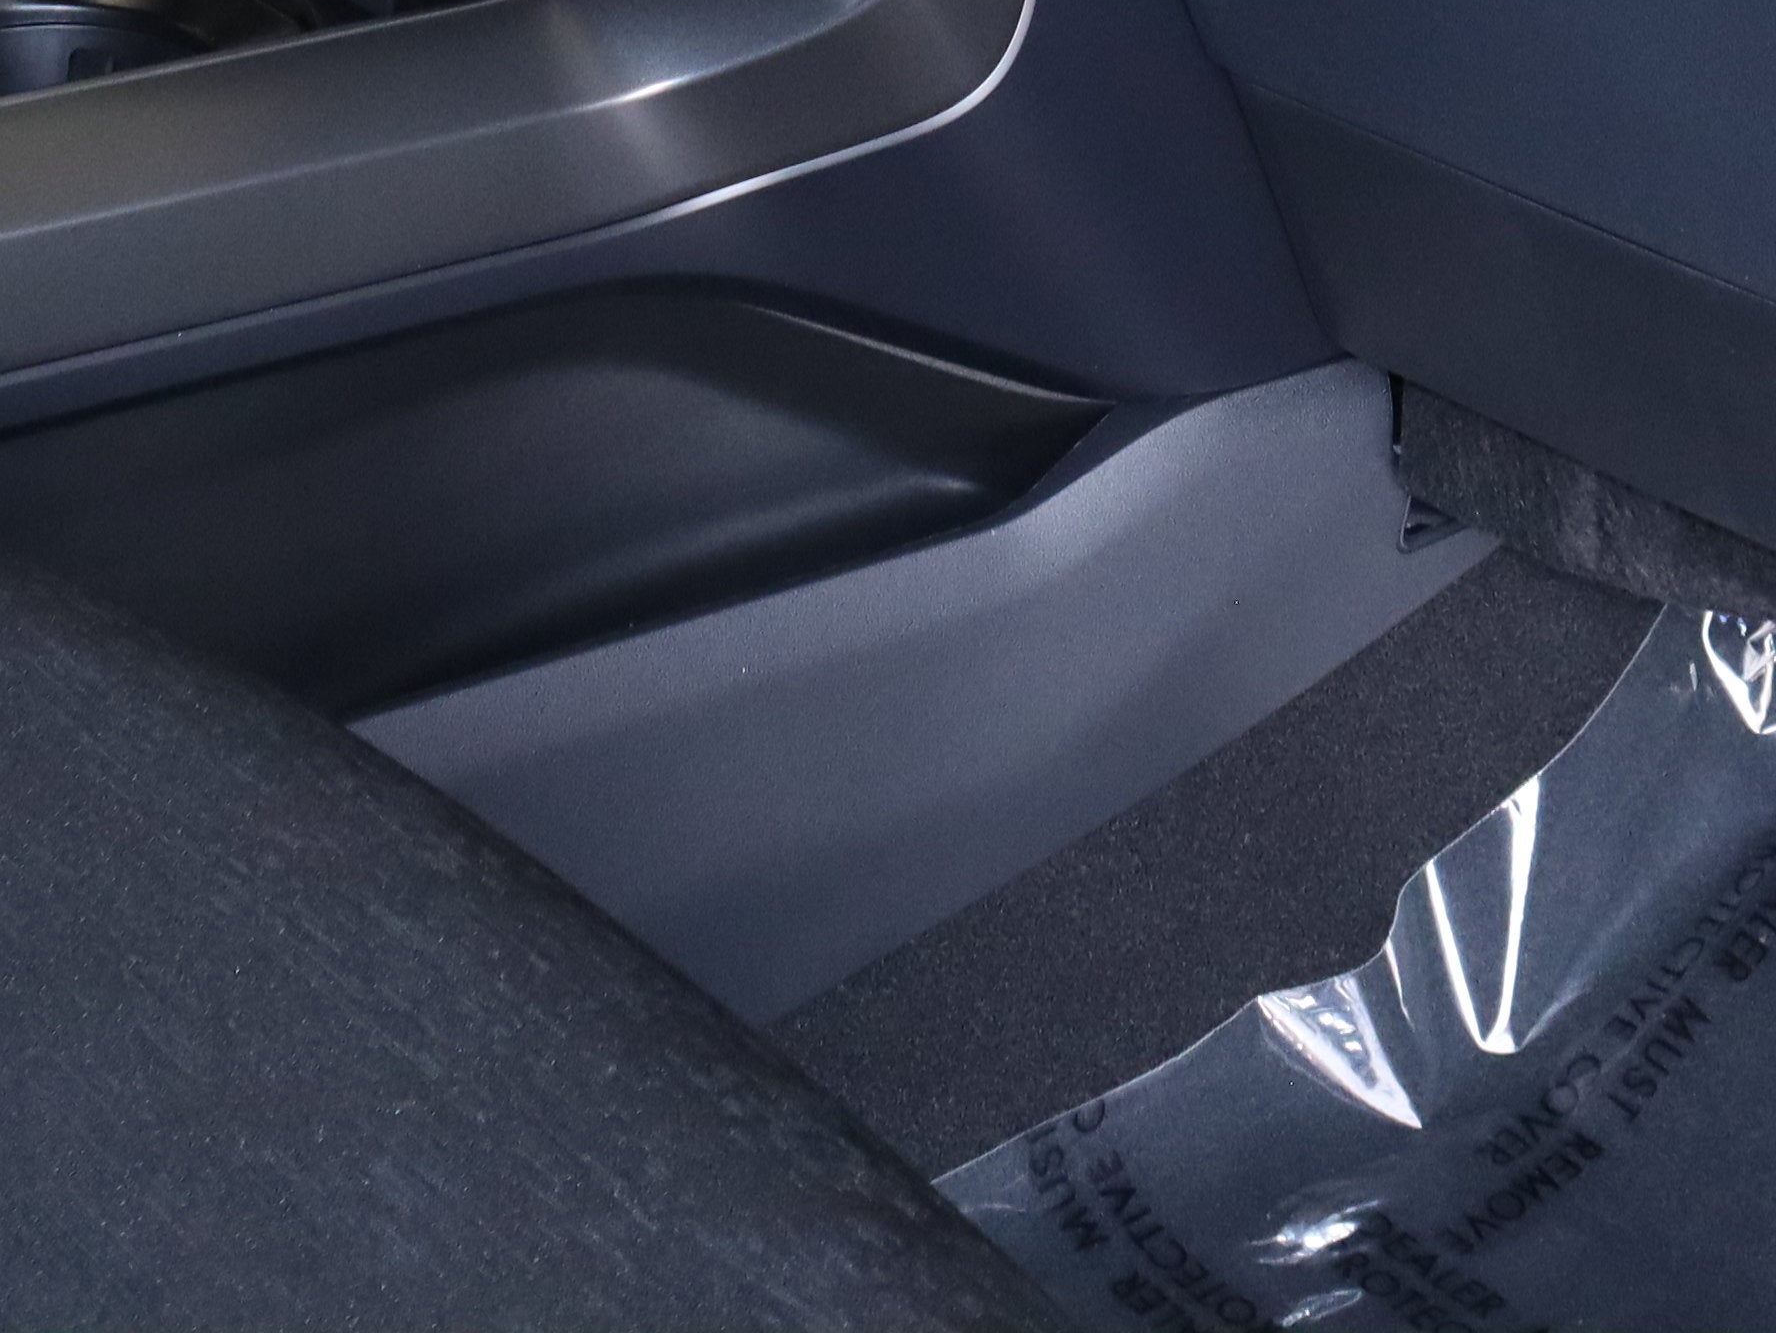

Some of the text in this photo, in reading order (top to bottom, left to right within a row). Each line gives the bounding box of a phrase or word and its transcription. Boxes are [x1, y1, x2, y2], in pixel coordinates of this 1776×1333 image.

[1479, 1048, 1604, 1167] COVER
[1606, 992, 1713, 1124] MUST
[1088, 1150, 1264, 1330] OTECTIVE
[1443, 1130, 1609, 1255] REMOVE
